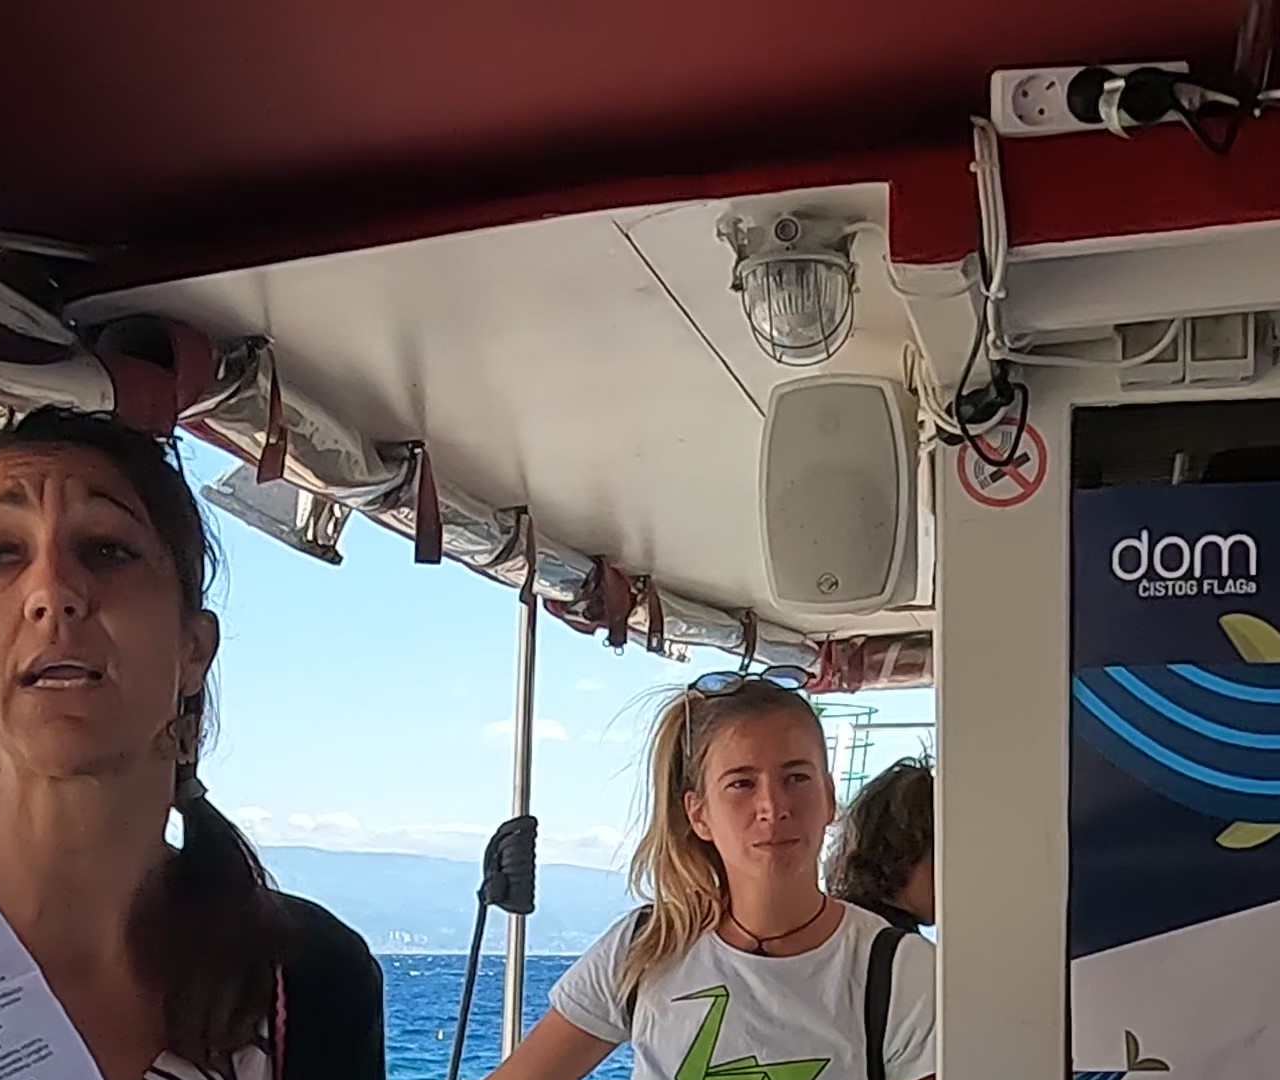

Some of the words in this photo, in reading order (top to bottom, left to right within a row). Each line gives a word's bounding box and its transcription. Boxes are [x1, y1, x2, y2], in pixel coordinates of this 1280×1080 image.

[1112, 529, 1257, 581] dom
[1138, 578, 1198, 597] ČISTOG
[1203, 578, 1257, 594] FLAGa
